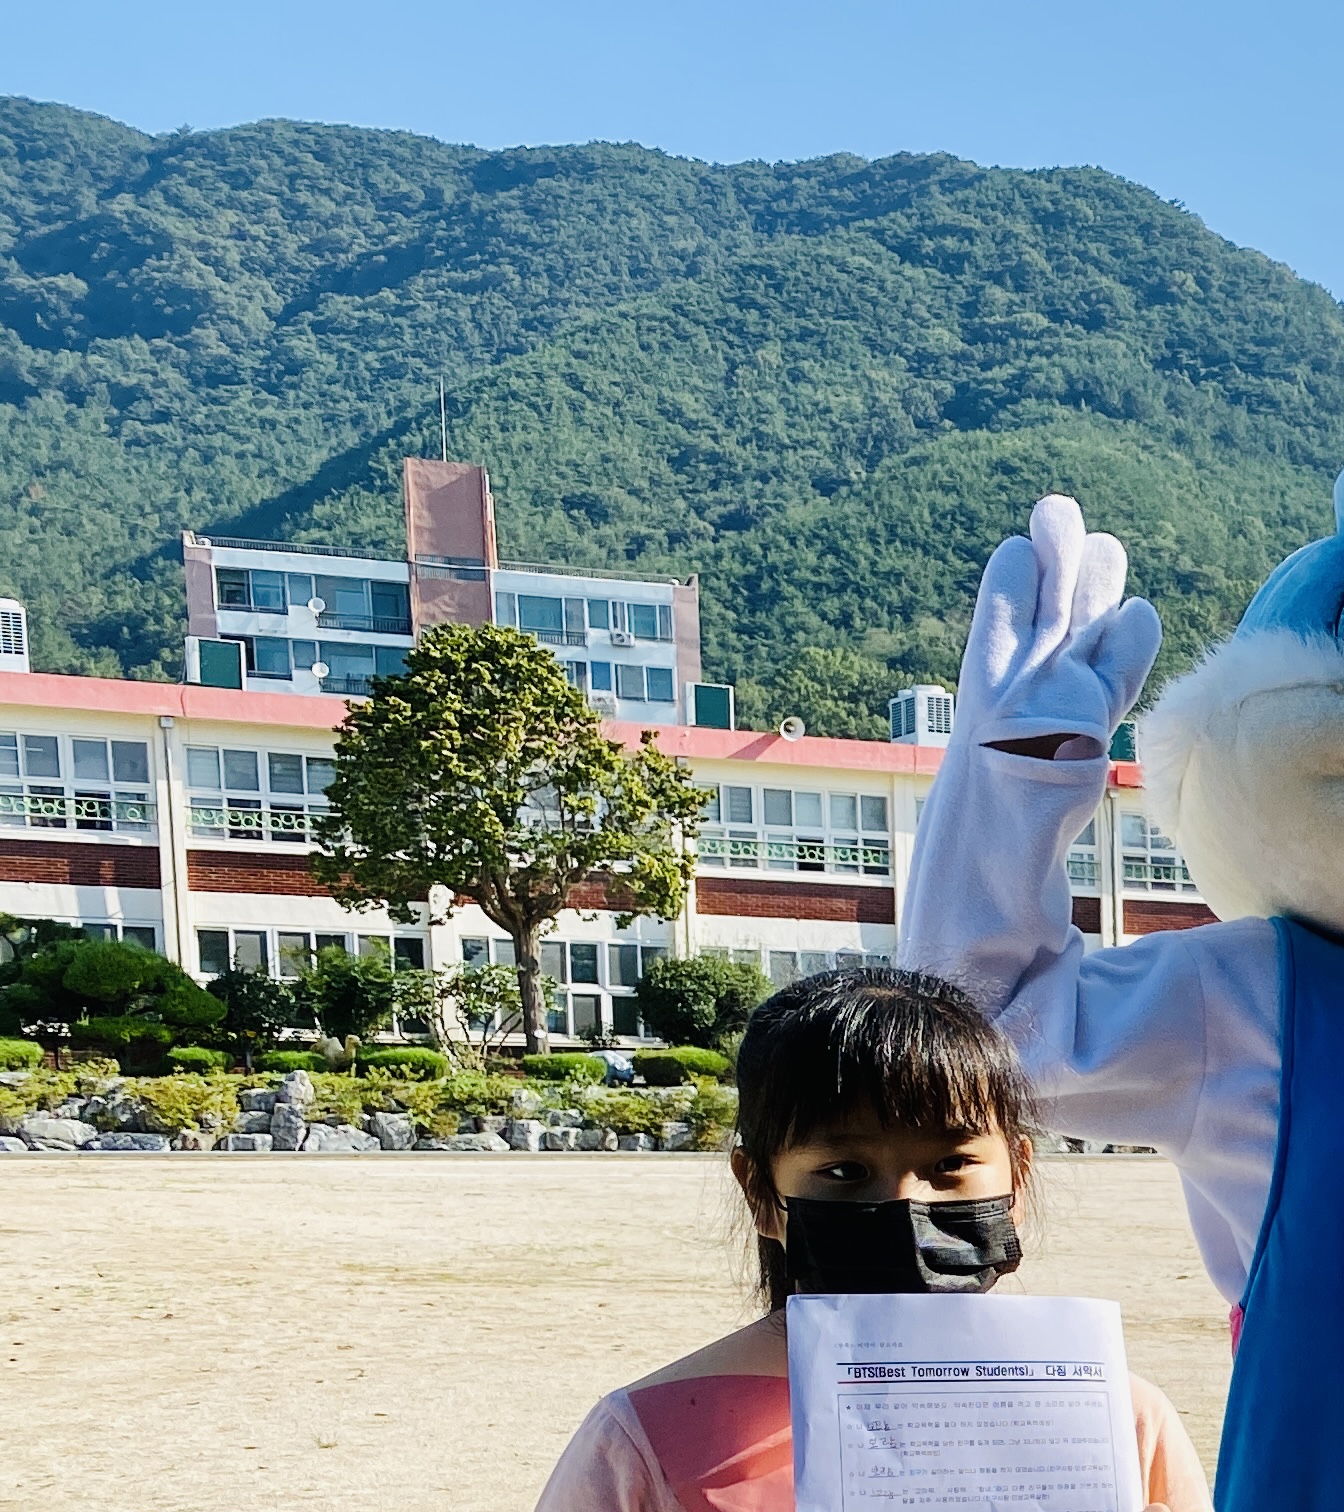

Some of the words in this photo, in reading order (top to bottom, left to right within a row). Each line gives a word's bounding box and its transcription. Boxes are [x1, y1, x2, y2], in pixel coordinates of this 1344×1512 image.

[911, 1366, 970, 1378] Tomorrow
[1045, 1365, 1067, 1377] 다짐
[1072, 1365, 1103, 1378] 서약서
